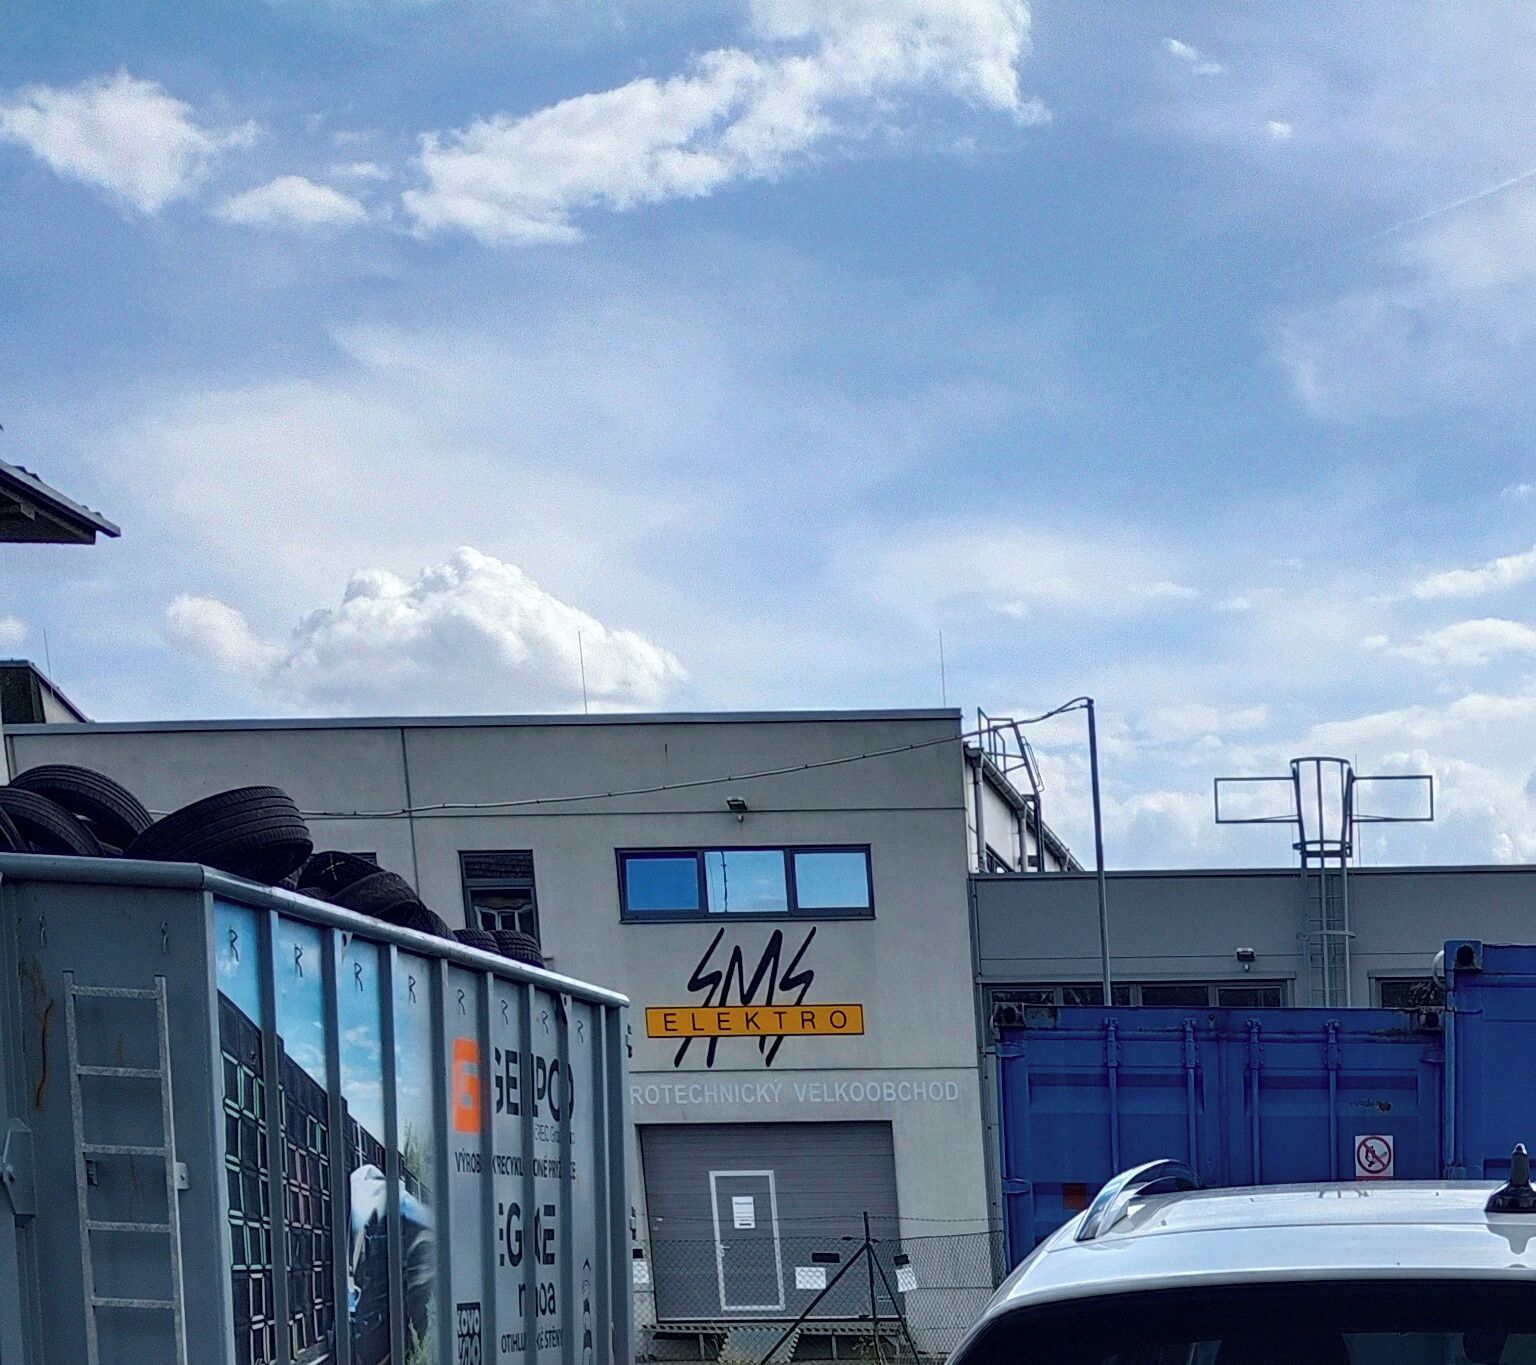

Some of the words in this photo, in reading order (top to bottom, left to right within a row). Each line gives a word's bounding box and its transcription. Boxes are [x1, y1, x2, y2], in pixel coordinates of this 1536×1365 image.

[673, 926, 817, 1068] SMS
[663, 1009, 848, 1032] ELEKTRO
[793, 1081, 959, 1102] VELKOOBCHOD
